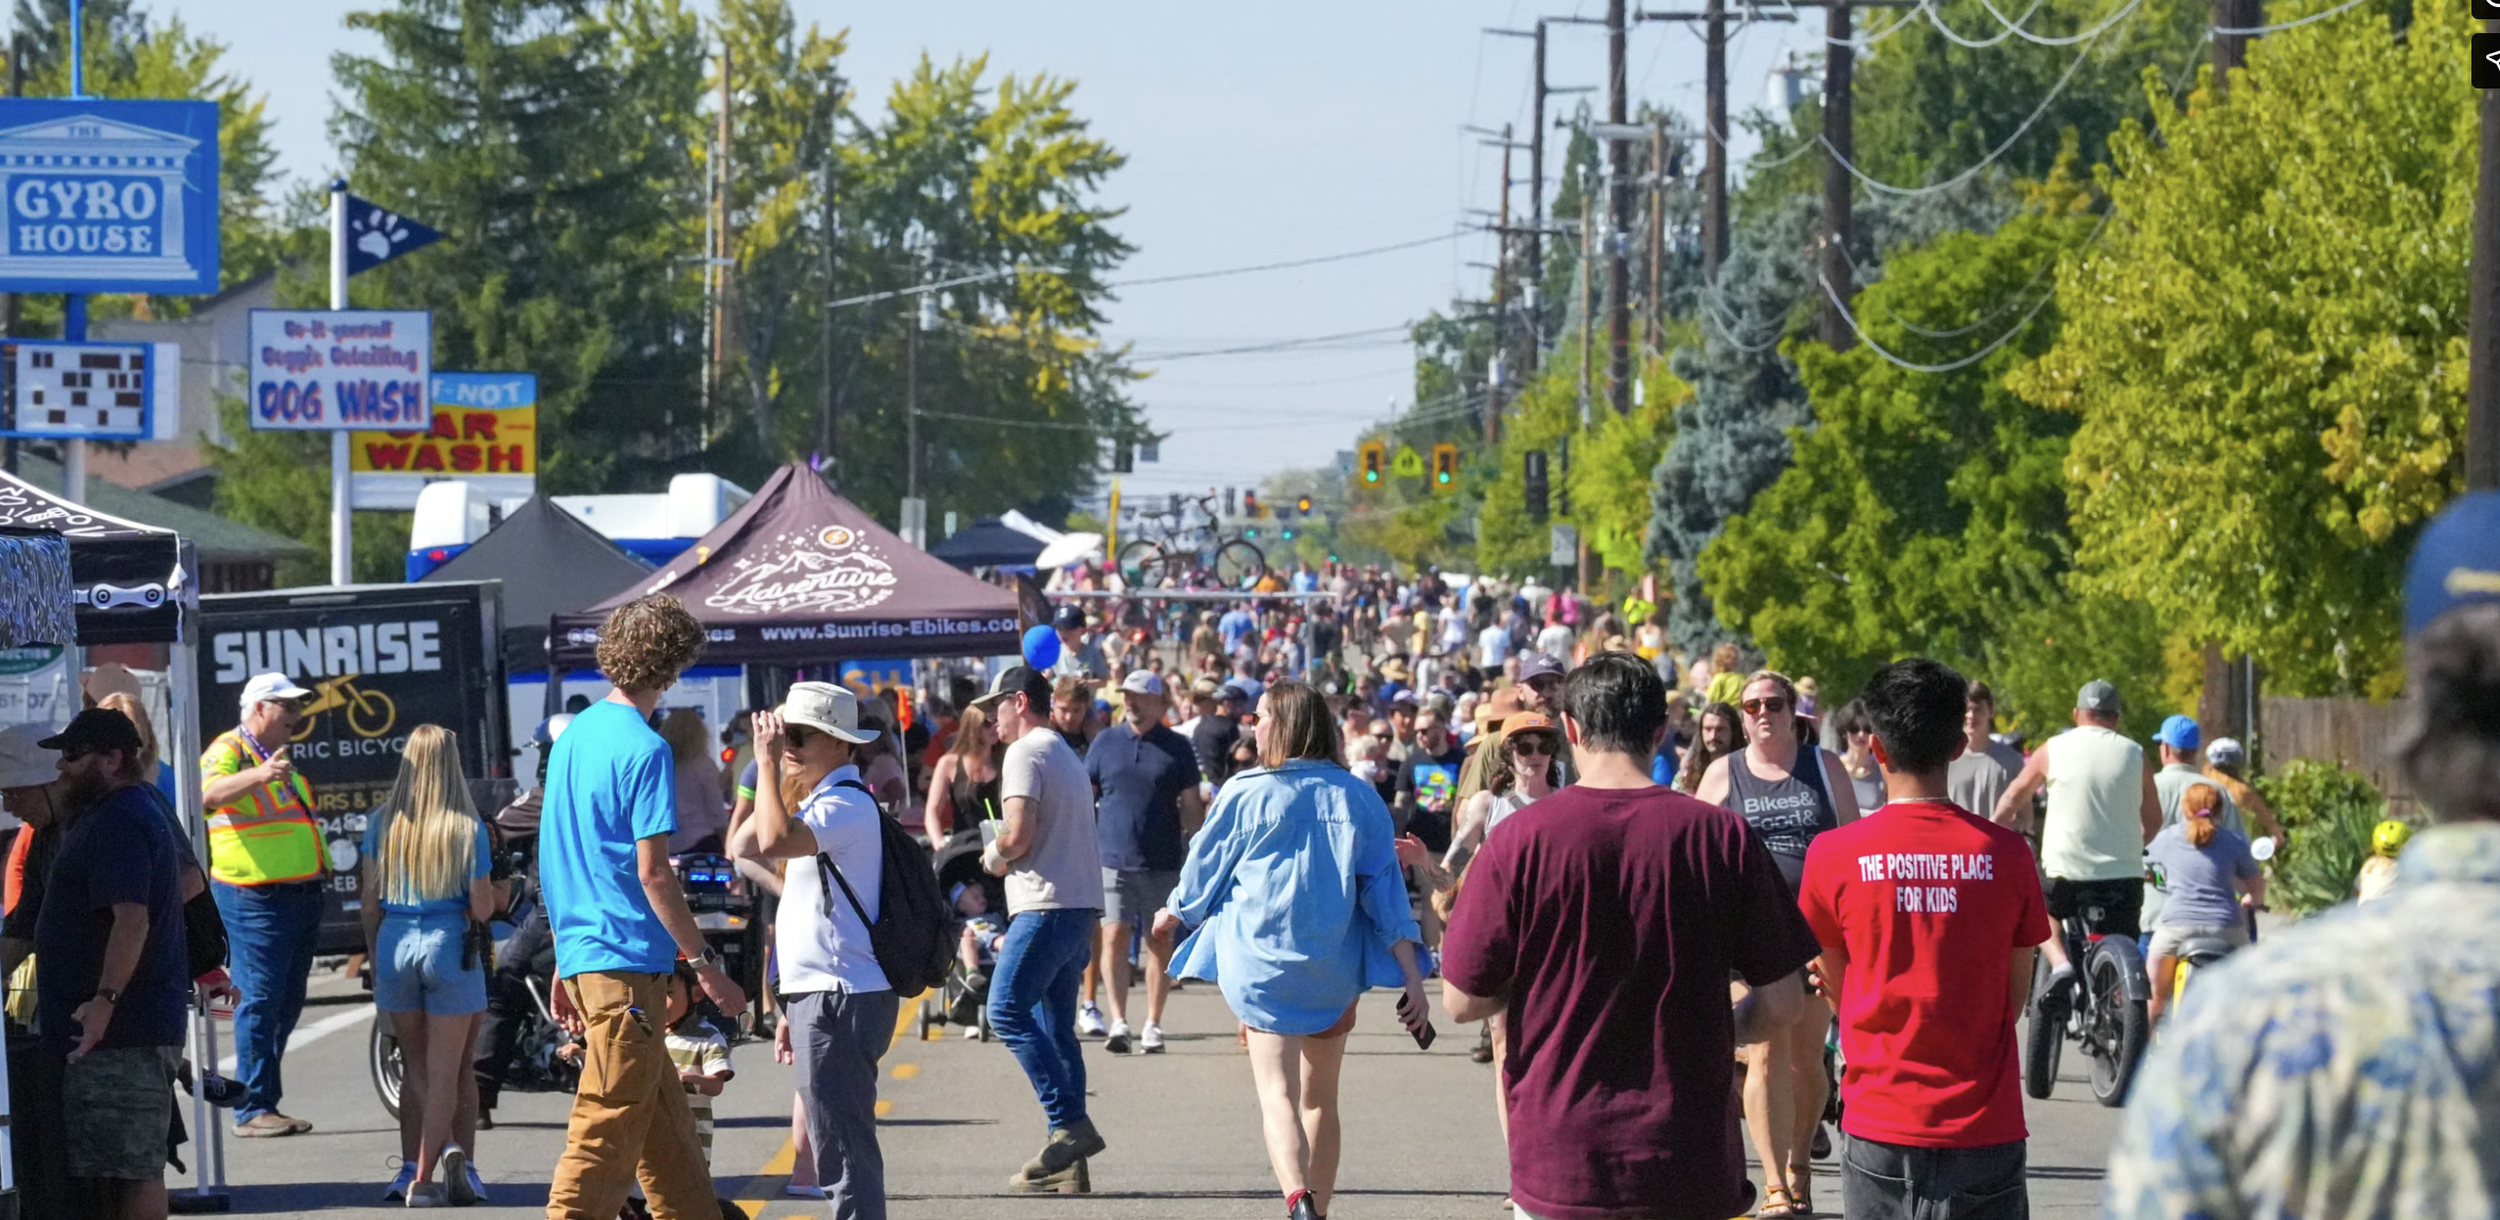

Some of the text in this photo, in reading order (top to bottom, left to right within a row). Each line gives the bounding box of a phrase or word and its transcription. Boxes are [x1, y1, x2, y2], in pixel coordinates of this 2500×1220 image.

[69, 126, 101, 137] THE
[15, 180, 156, 220] GYRO
[19, 225, 152, 252] HOUSE
[258, 378, 422, 422] DOG WASH
[366, 442, 523, 472] WASH
[705, 567, 897, 607] Adventure
[213, 620, 441, 684] SUNRISE
[1744, 792, 1816, 814] Bikes&
[1858, 853, 1994, 882] THE POSITIVE PLACE
[1896, 886, 1957, 912] FOR KIDS
